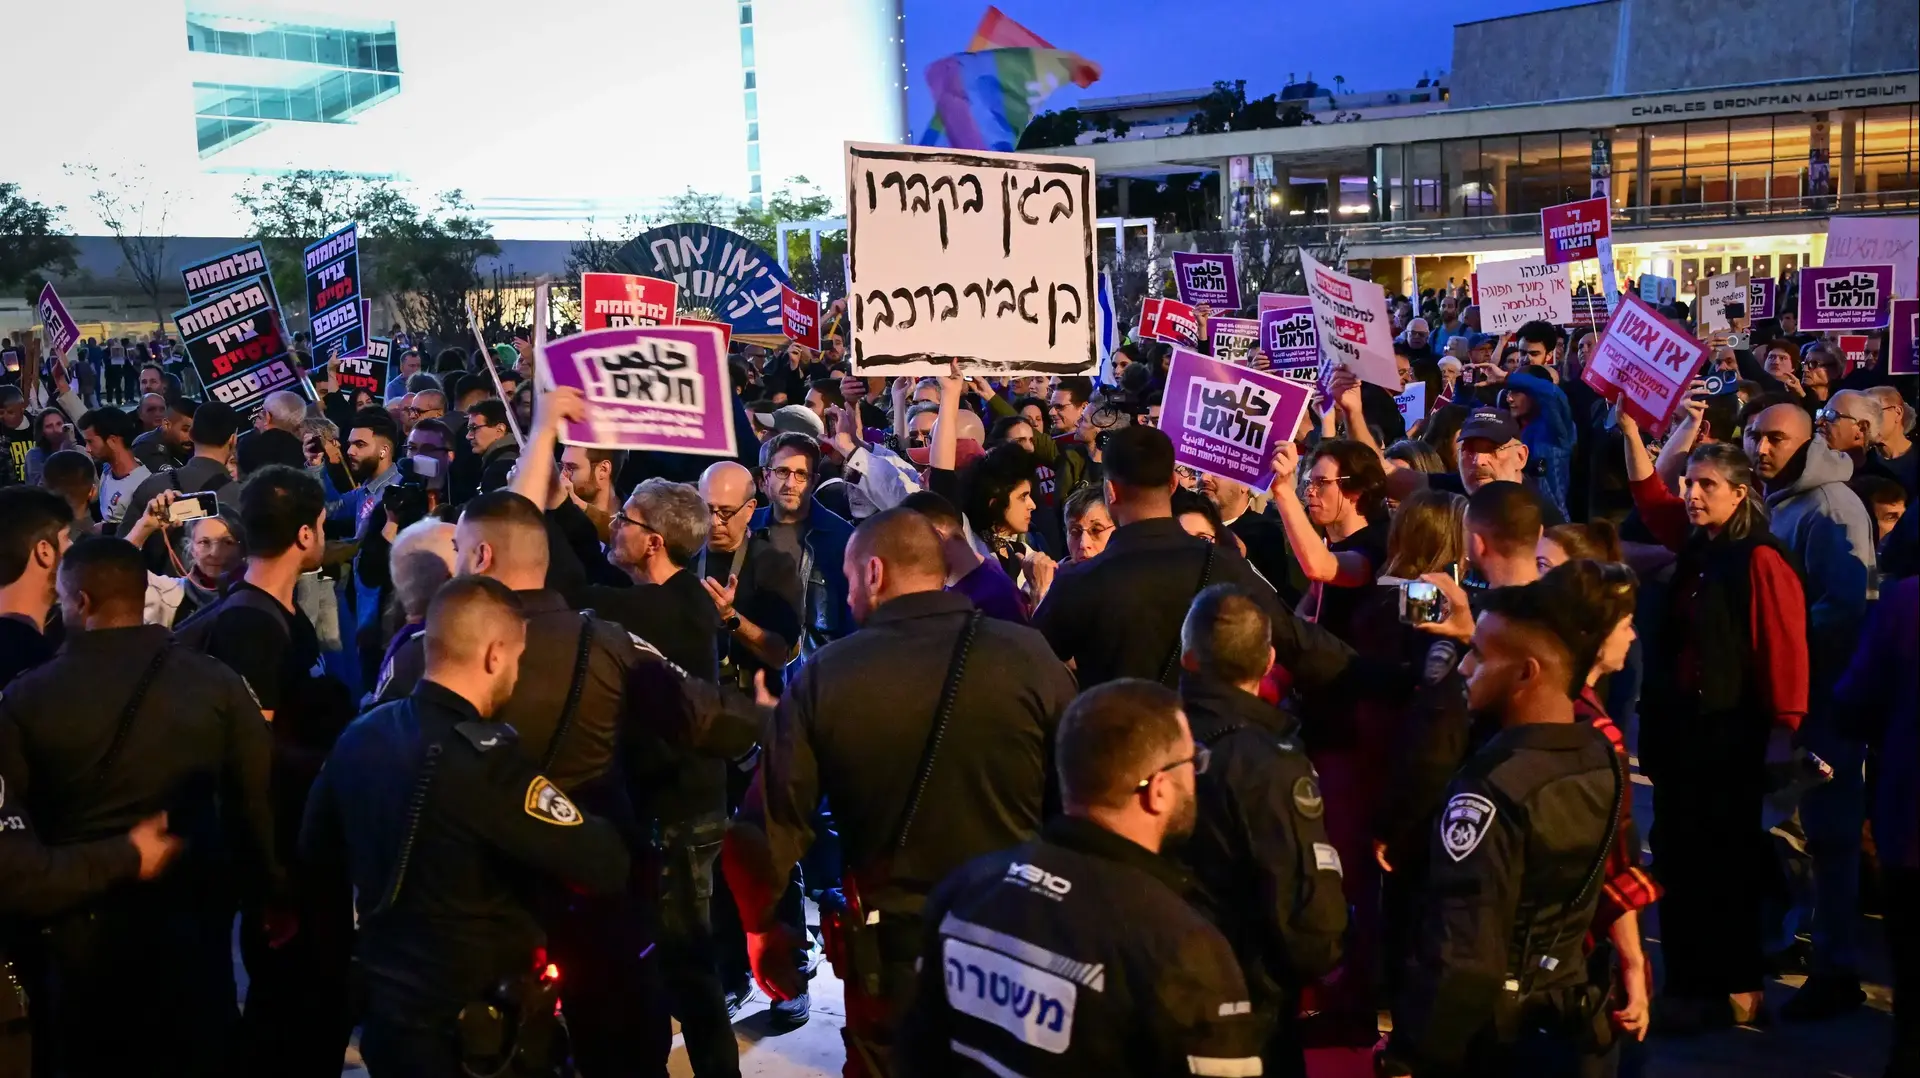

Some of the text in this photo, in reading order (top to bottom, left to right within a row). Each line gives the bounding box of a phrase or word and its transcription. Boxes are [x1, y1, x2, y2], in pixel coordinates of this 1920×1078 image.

[1631, 84, 1907, 116] CHARLES BRONFMAN AUDITORIUM
[865, 169, 1074, 258] בגין בקברו
[1566, 208, 1580, 220] די
[1549, 218, 1601, 240] למלחמת
[306, 230, 355, 270] מלחמות
[1560, 234, 1592, 251] הנצח
[650, 236, 710, 272] את
[185, 250, 264, 291] מלחמות
[318, 260, 346, 289] צריך
[1190, 262, 1222, 276] خلص
[315, 276, 353, 310] לסיים.
[625, 283, 646, 299] די
[1480, 278, 1565, 298] אין מועד תפוגה
[1716, 280, 1729, 290] Stop
[1826, 274, 1874, 292] خلص
[673, 270, 756, 320] היום!
[792, 298, 800, 307] די
[1502, 293, 1547, 311] למלחמה
[1710, 296, 1720, 306] the
[1722, 292, 1744, 303] endless
[178, 286, 266, 336] מלחמות
[312, 300, 357, 336] בהסכם
[594, 300, 668, 320] למלחמת
[784, 304, 813, 326] למלחמת
[854, 276, 1082, 349] בן גביר ברכבו
[1512, 314, 1527, 323] יש
[1716, 308, 1726, 316] wa
[788, 318, 807, 336] הנצח
[1166, 312, 1198, 334] לחמת
[1175, 323, 1198, 343] נצח
[1276, 314, 1312, 334] خلص
[206, 318, 259, 354] צריך
[1616, 310, 1690, 372] אין אמון
[211, 326, 280, 379] לסיים.
[600, 343, 687, 370] خلص
[212, 360, 293, 402] בהסכם
[1202, 386, 1271, 416] خلص
[1395, 394, 1416, 403] למלח
[1186, 383, 1266, 449] חלאס!
[1205, 440, 1228, 456] للحرب
[1228, 446, 1241, 458] حدا
[1180, 444, 1260, 476] שמים סוף למלחמת הנצח
[947, 957, 1065, 1033] משטרה
